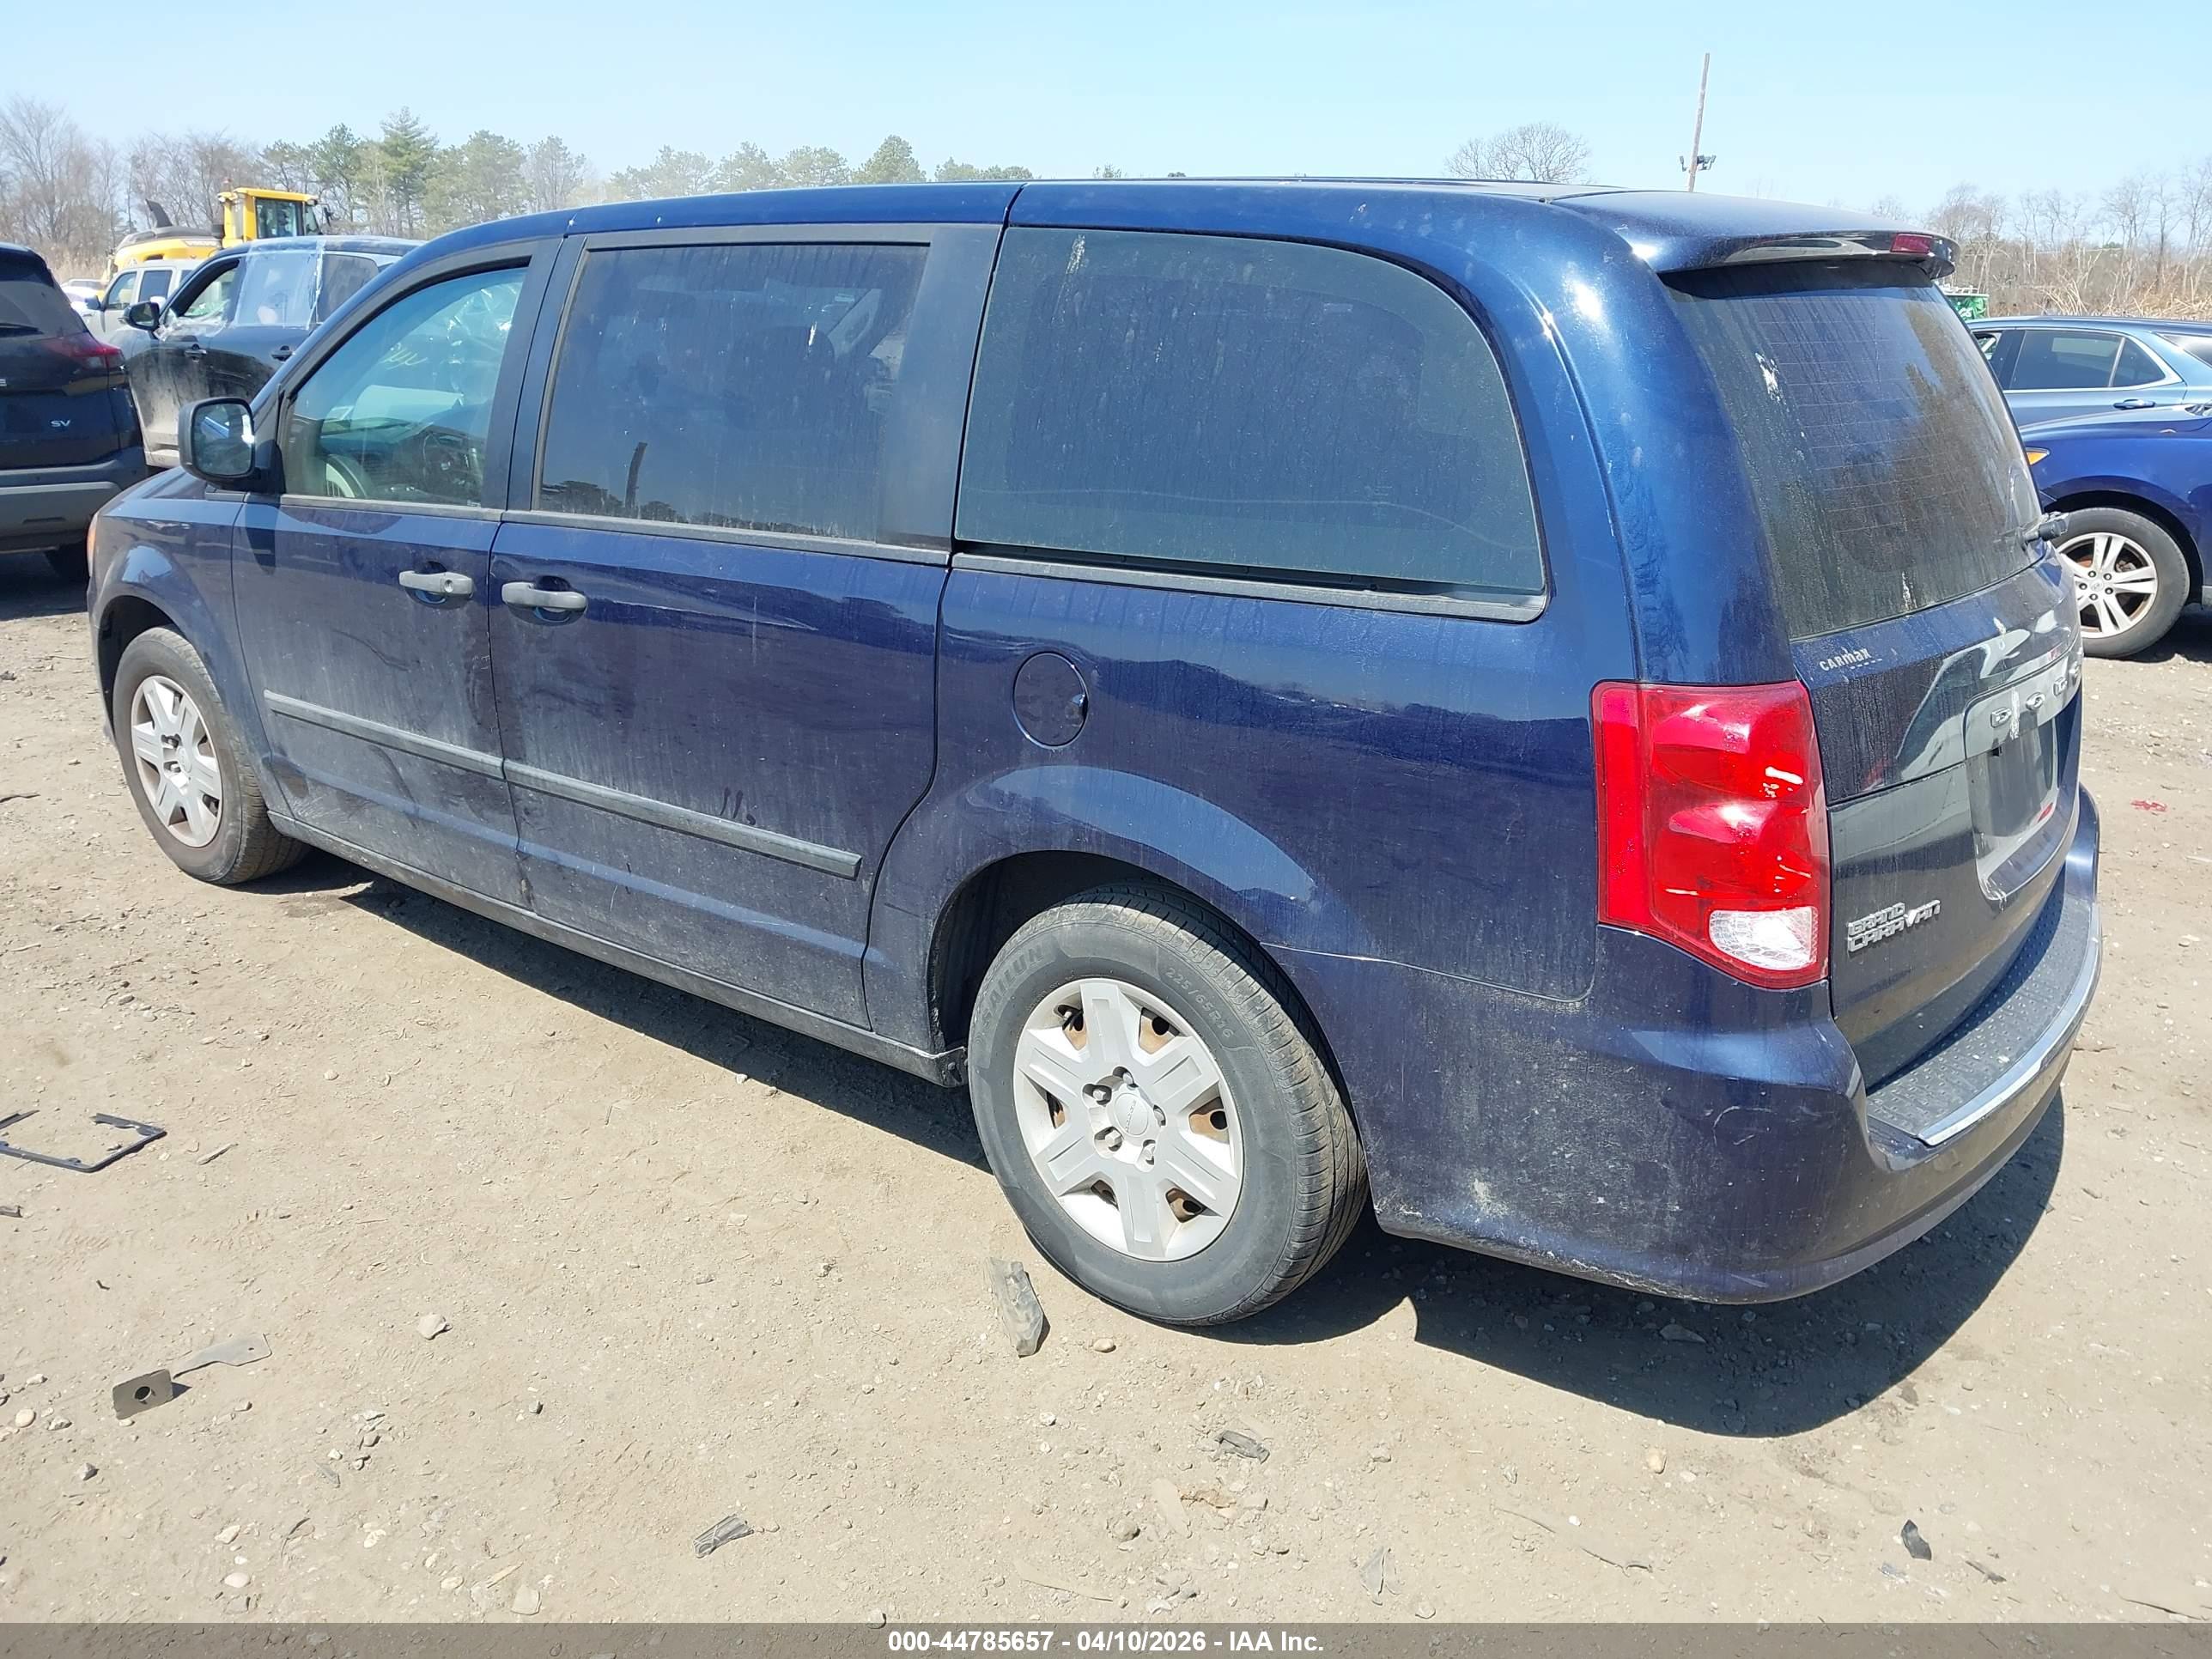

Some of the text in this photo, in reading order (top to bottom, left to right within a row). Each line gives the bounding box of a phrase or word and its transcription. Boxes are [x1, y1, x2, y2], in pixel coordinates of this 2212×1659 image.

[1847, 902, 1905, 937] GRAND
[1847, 899, 1941, 952] CARAVAN
[1164, 967, 1235, 1038] 225/65R16
